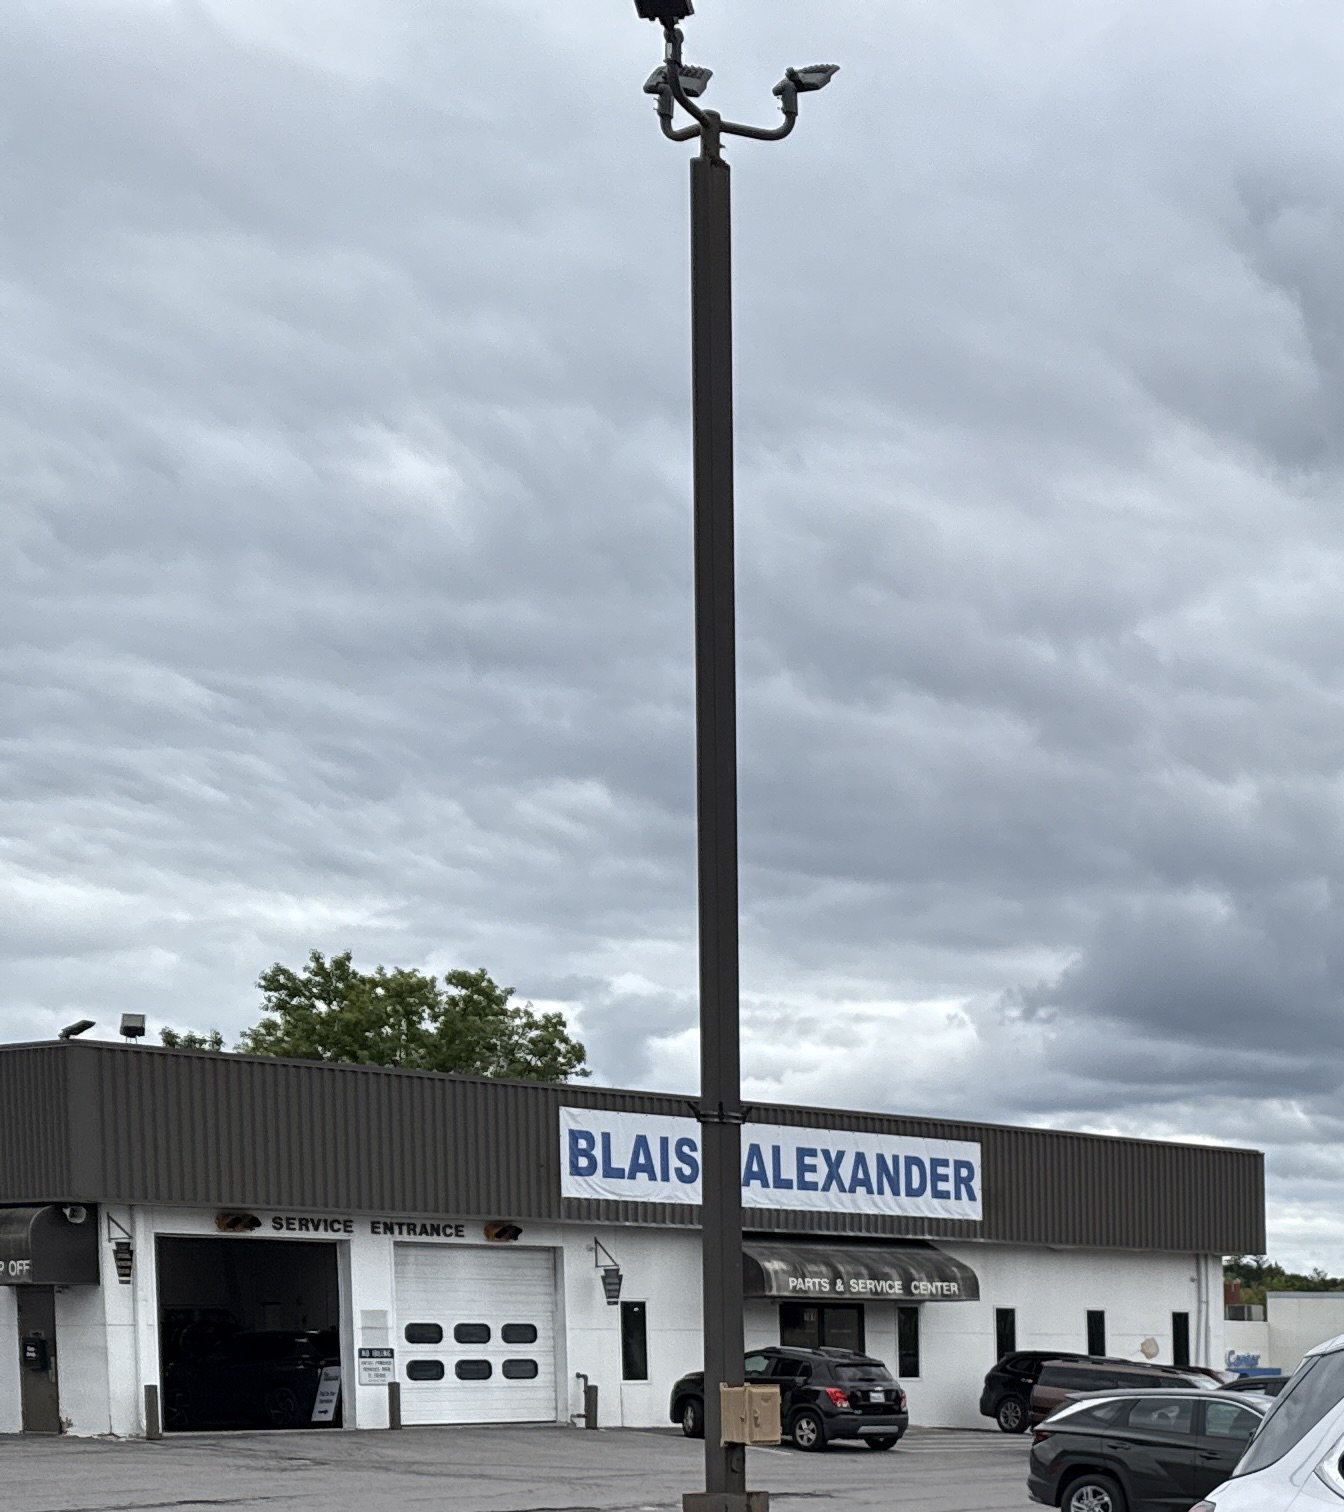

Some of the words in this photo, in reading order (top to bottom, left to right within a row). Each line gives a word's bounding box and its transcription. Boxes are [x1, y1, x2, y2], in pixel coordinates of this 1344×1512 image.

[568, 1128, 699, 1184] BLAIS
[741, 1143, 977, 1201] ALEXANDER
[272, 1216, 354, 1234] SERVICE
[370, 1220, 465, 1238] ENTRANCE
[8, 1260, 31, 1276] OFF
[788, 1277, 830, 1292] PARTS
[835, 1278, 844, 1292] &
[850, 1279, 904, 1294] SERVICE
[911, 1281, 959, 1295] CENTER
